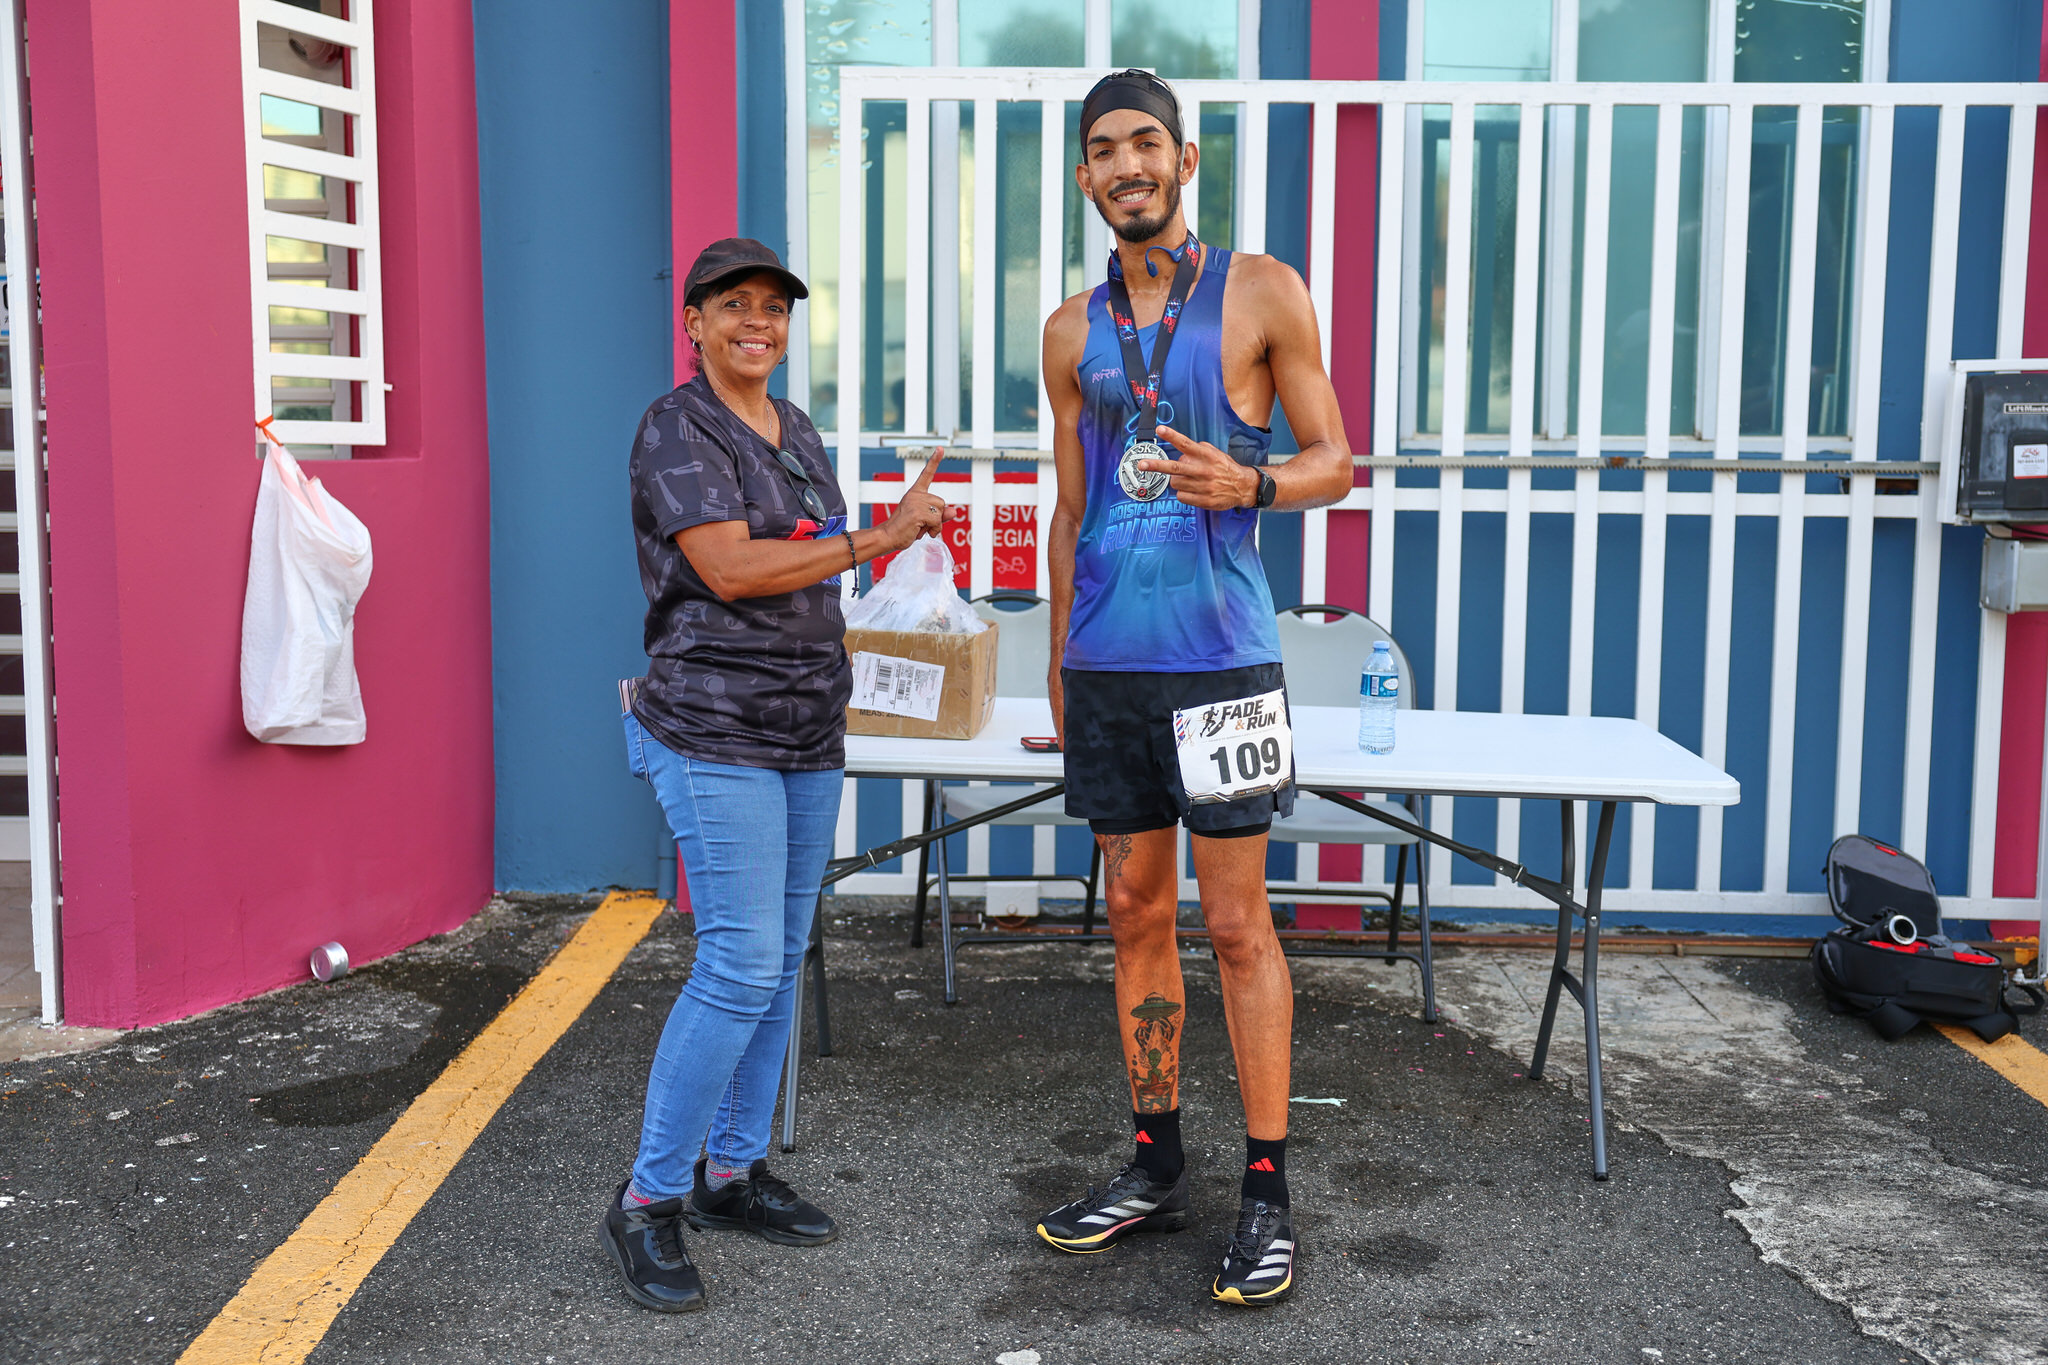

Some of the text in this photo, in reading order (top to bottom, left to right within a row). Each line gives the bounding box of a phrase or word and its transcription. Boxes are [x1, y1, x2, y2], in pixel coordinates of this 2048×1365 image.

[1121, 317, 1135, 335] 5K
[1137, 444, 1152, 453] 5K
[1221, 698, 1264, 721] FADE
[1235, 711, 1276, 731] & RUN
[1210, 737, 1281, 785] 109
